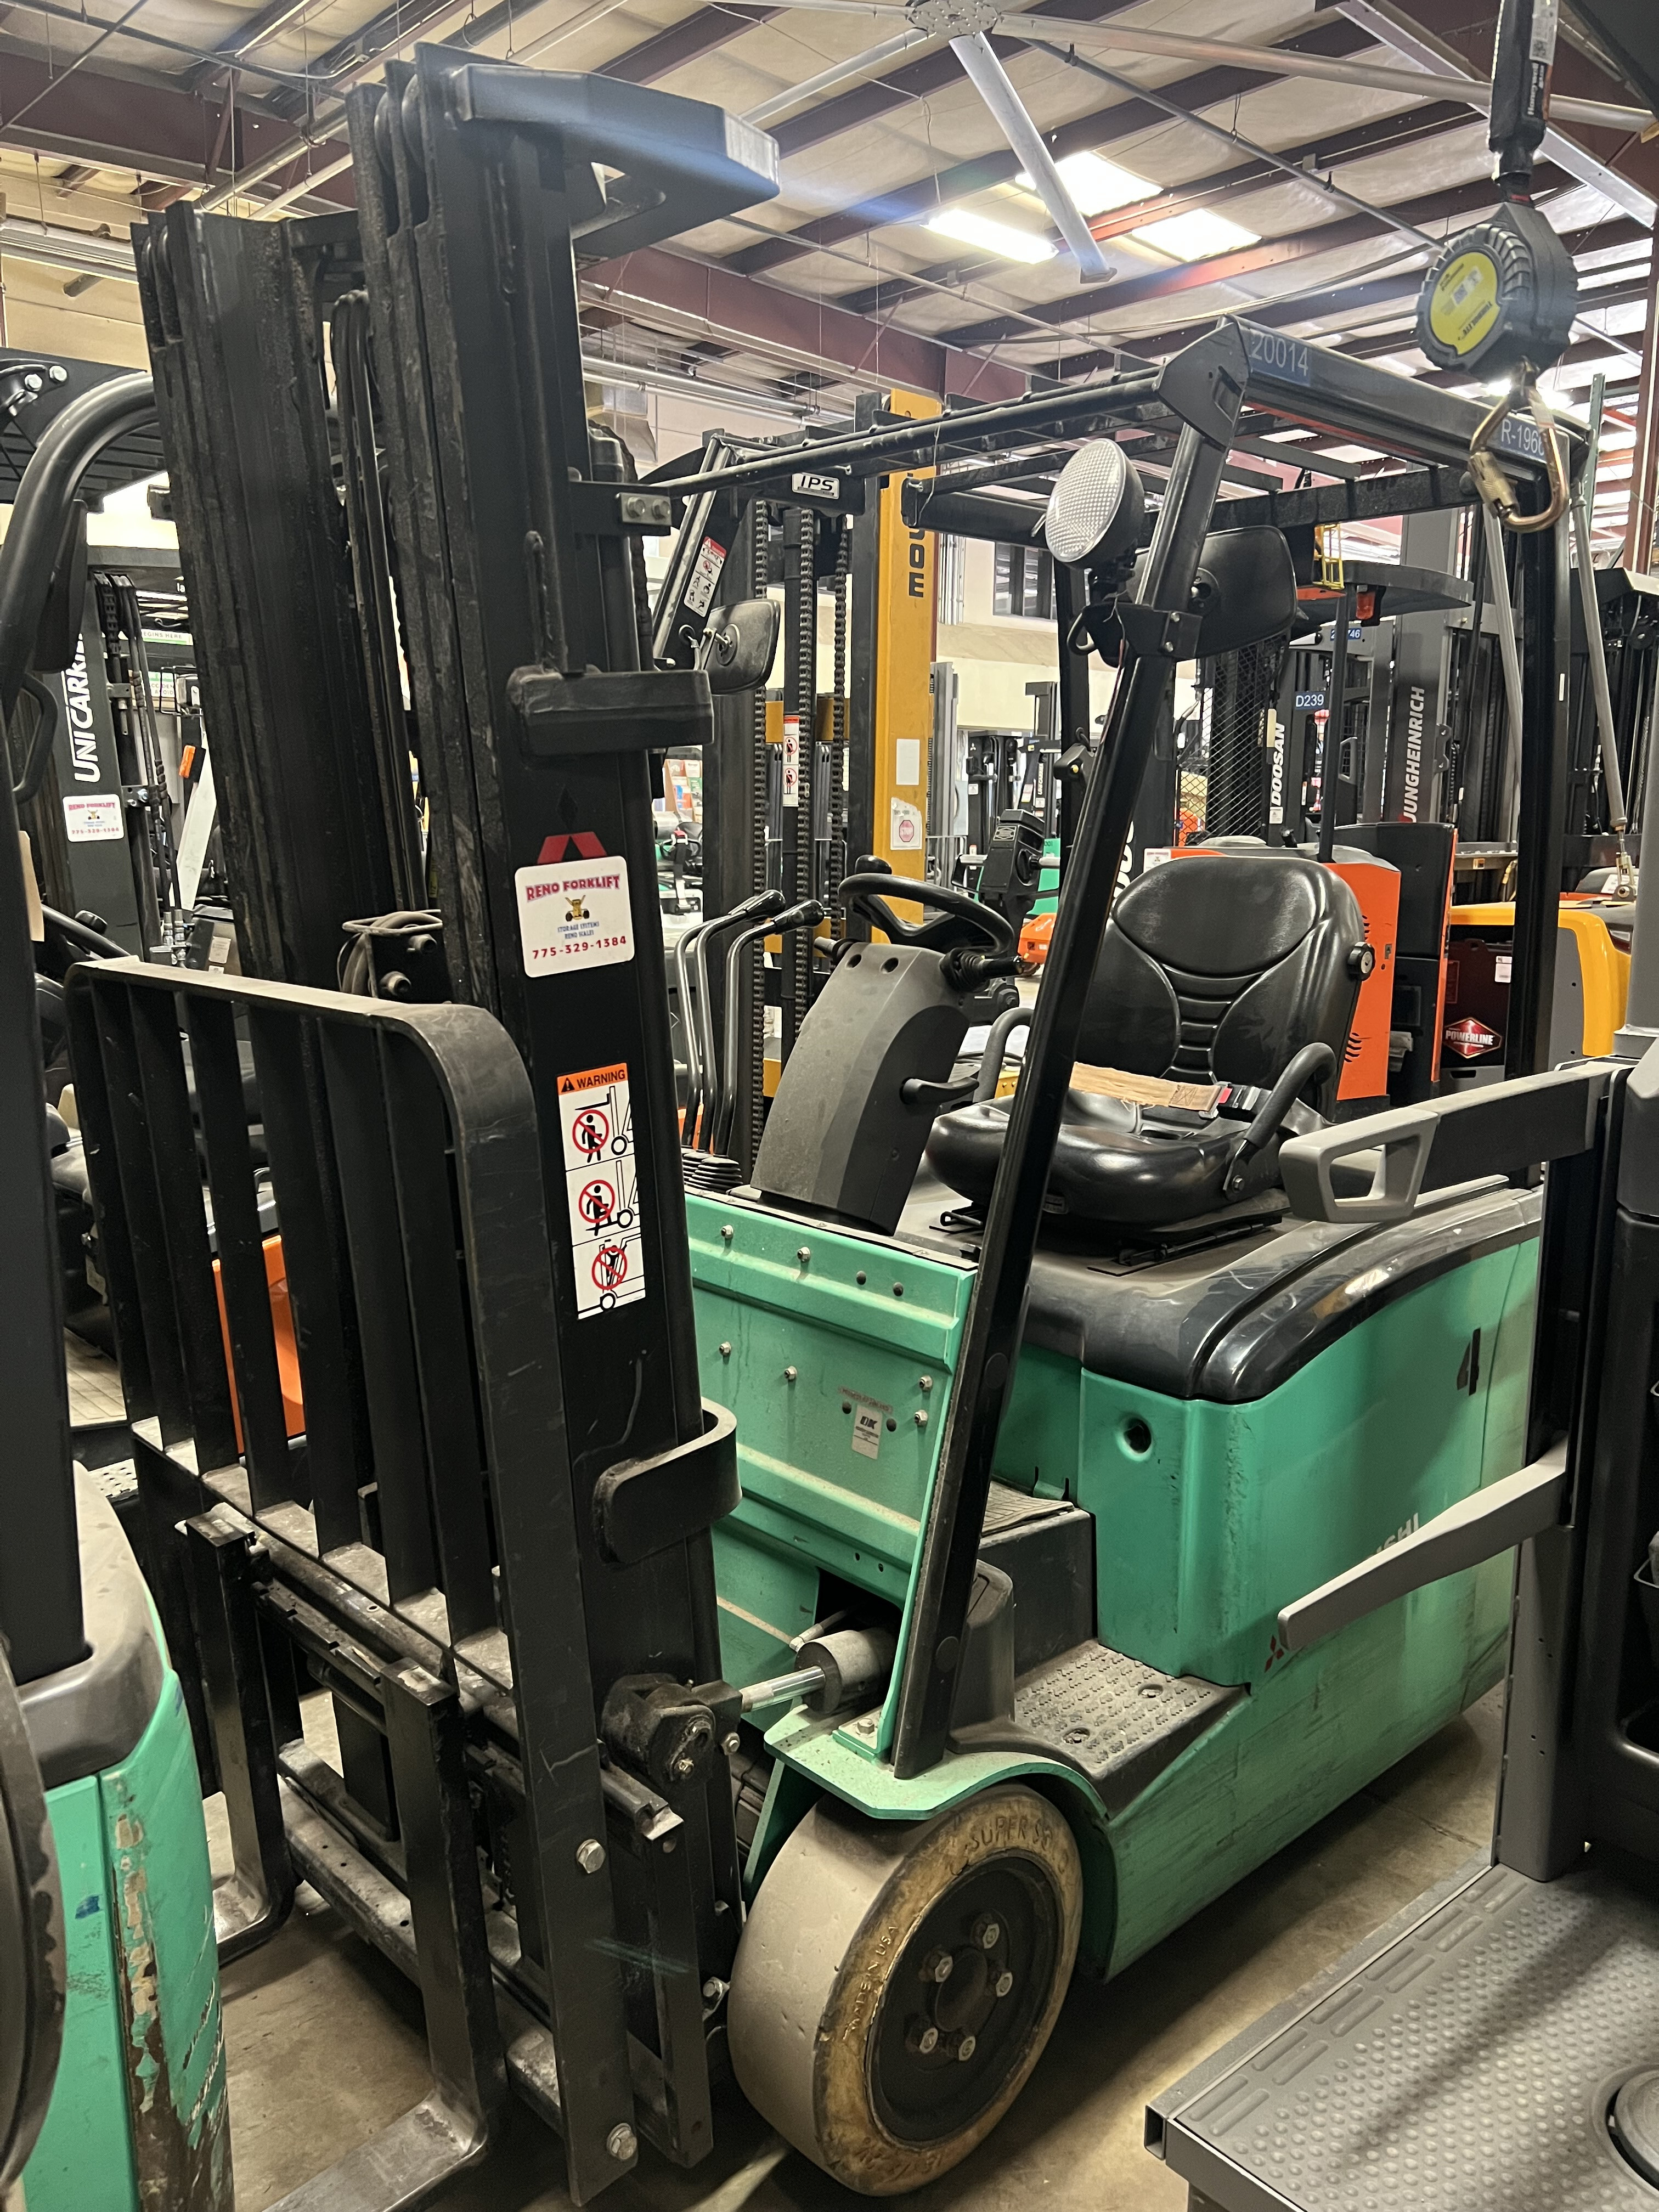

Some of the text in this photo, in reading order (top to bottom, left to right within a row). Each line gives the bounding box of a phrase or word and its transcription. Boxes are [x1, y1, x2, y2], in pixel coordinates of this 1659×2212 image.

[801, 475, 834, 491] IPS
[1295, 694, 1324, 707] D239
[1271, 723, 1285, 806] DOOSAN
[1403, 686, 1425, 823] JUNGHEINRICH
[526, 874, 621, 902] RENO FORKLIFT
[532, 935, 627, 960] 775-329-1384
[1445, 1030, 1495, 1046] POWERLINE
[577, 1069, 626, 1088] WARNING
[875, 1926, 899, 1956] USA
